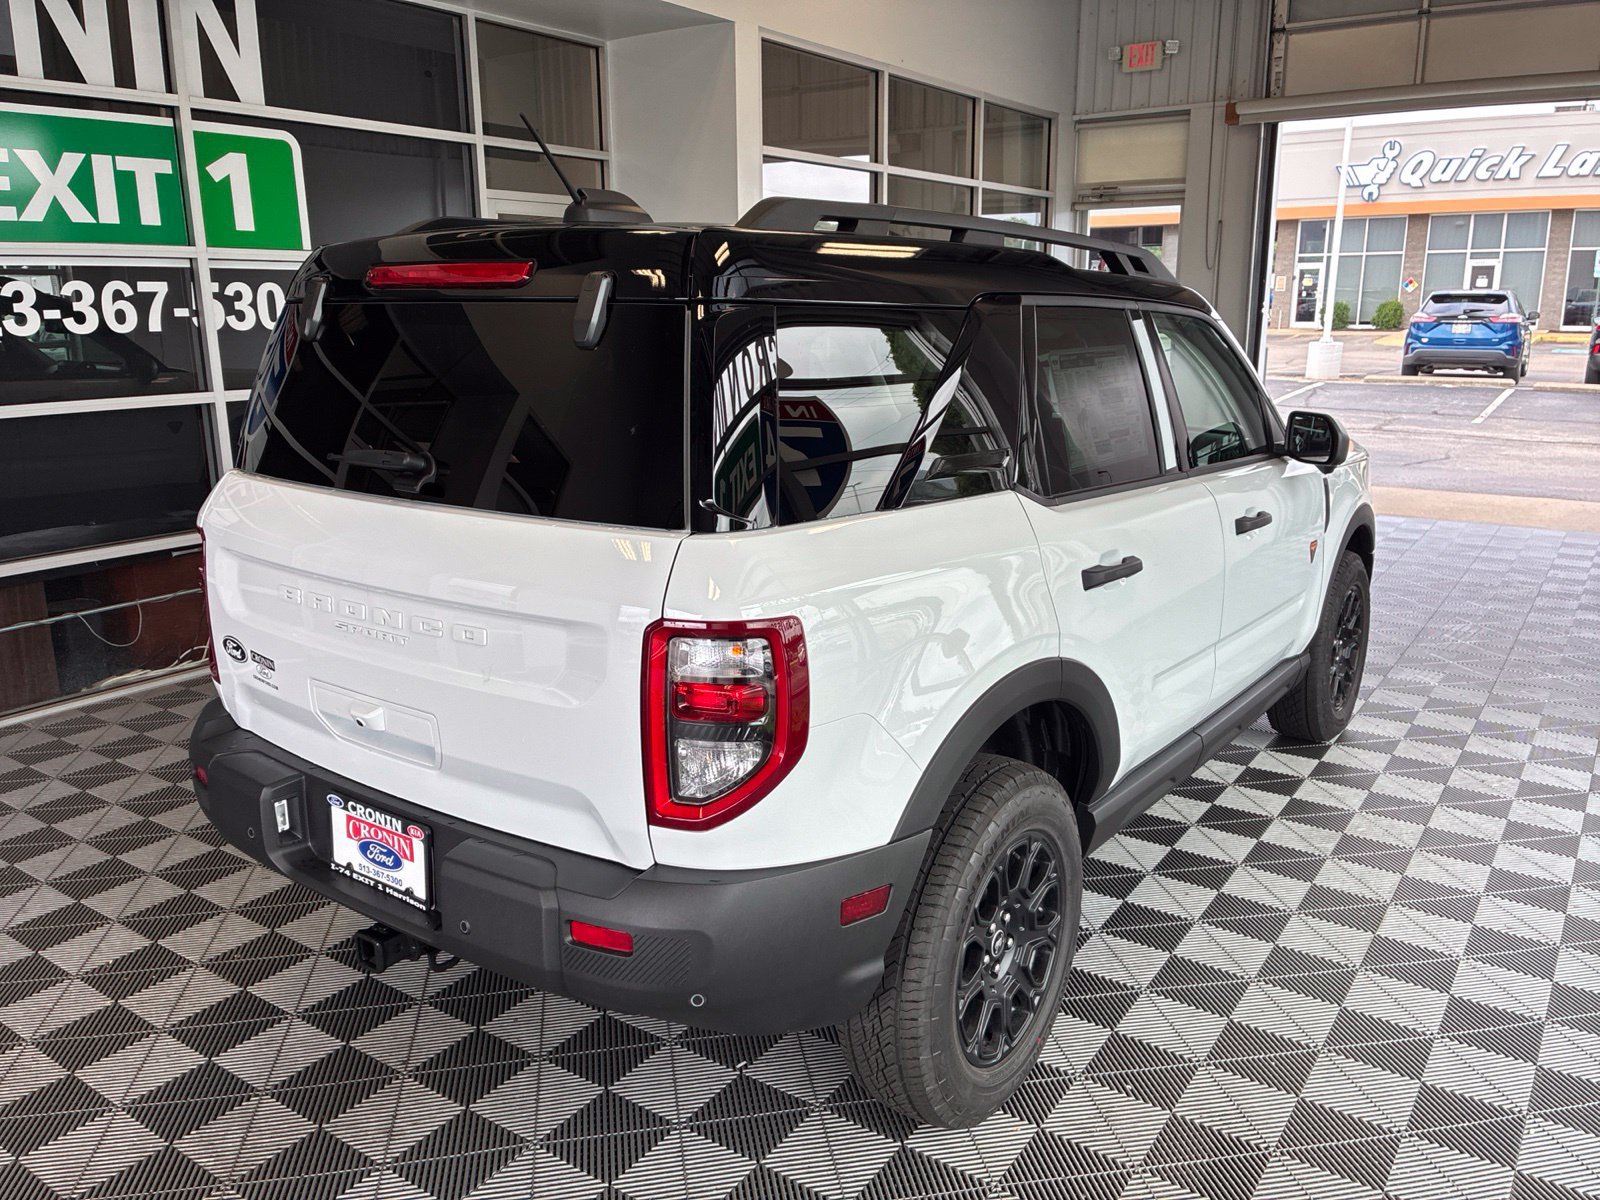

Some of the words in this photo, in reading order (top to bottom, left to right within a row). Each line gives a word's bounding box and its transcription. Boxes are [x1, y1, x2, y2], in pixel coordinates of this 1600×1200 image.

[1127, 43, 1157, 68] EXIT
[1399, 144, 1536, 188] Quick
[205, 152, 255, 232] 1
[0, 280, 286, 336] 3-367-530
[279, 583, 488, 646] BRONCO
[334, 619, 410, 646] SPORT
[347, 801, 402, 834] CRONIN
[409, 828, 421, 837] KIA
[349, 819, 411, 861] CRONIN
[367, 843, 395, 867] Ford
[352, 872, 376, 887] EXIT
[385, 886, 427, 911] Harrison
